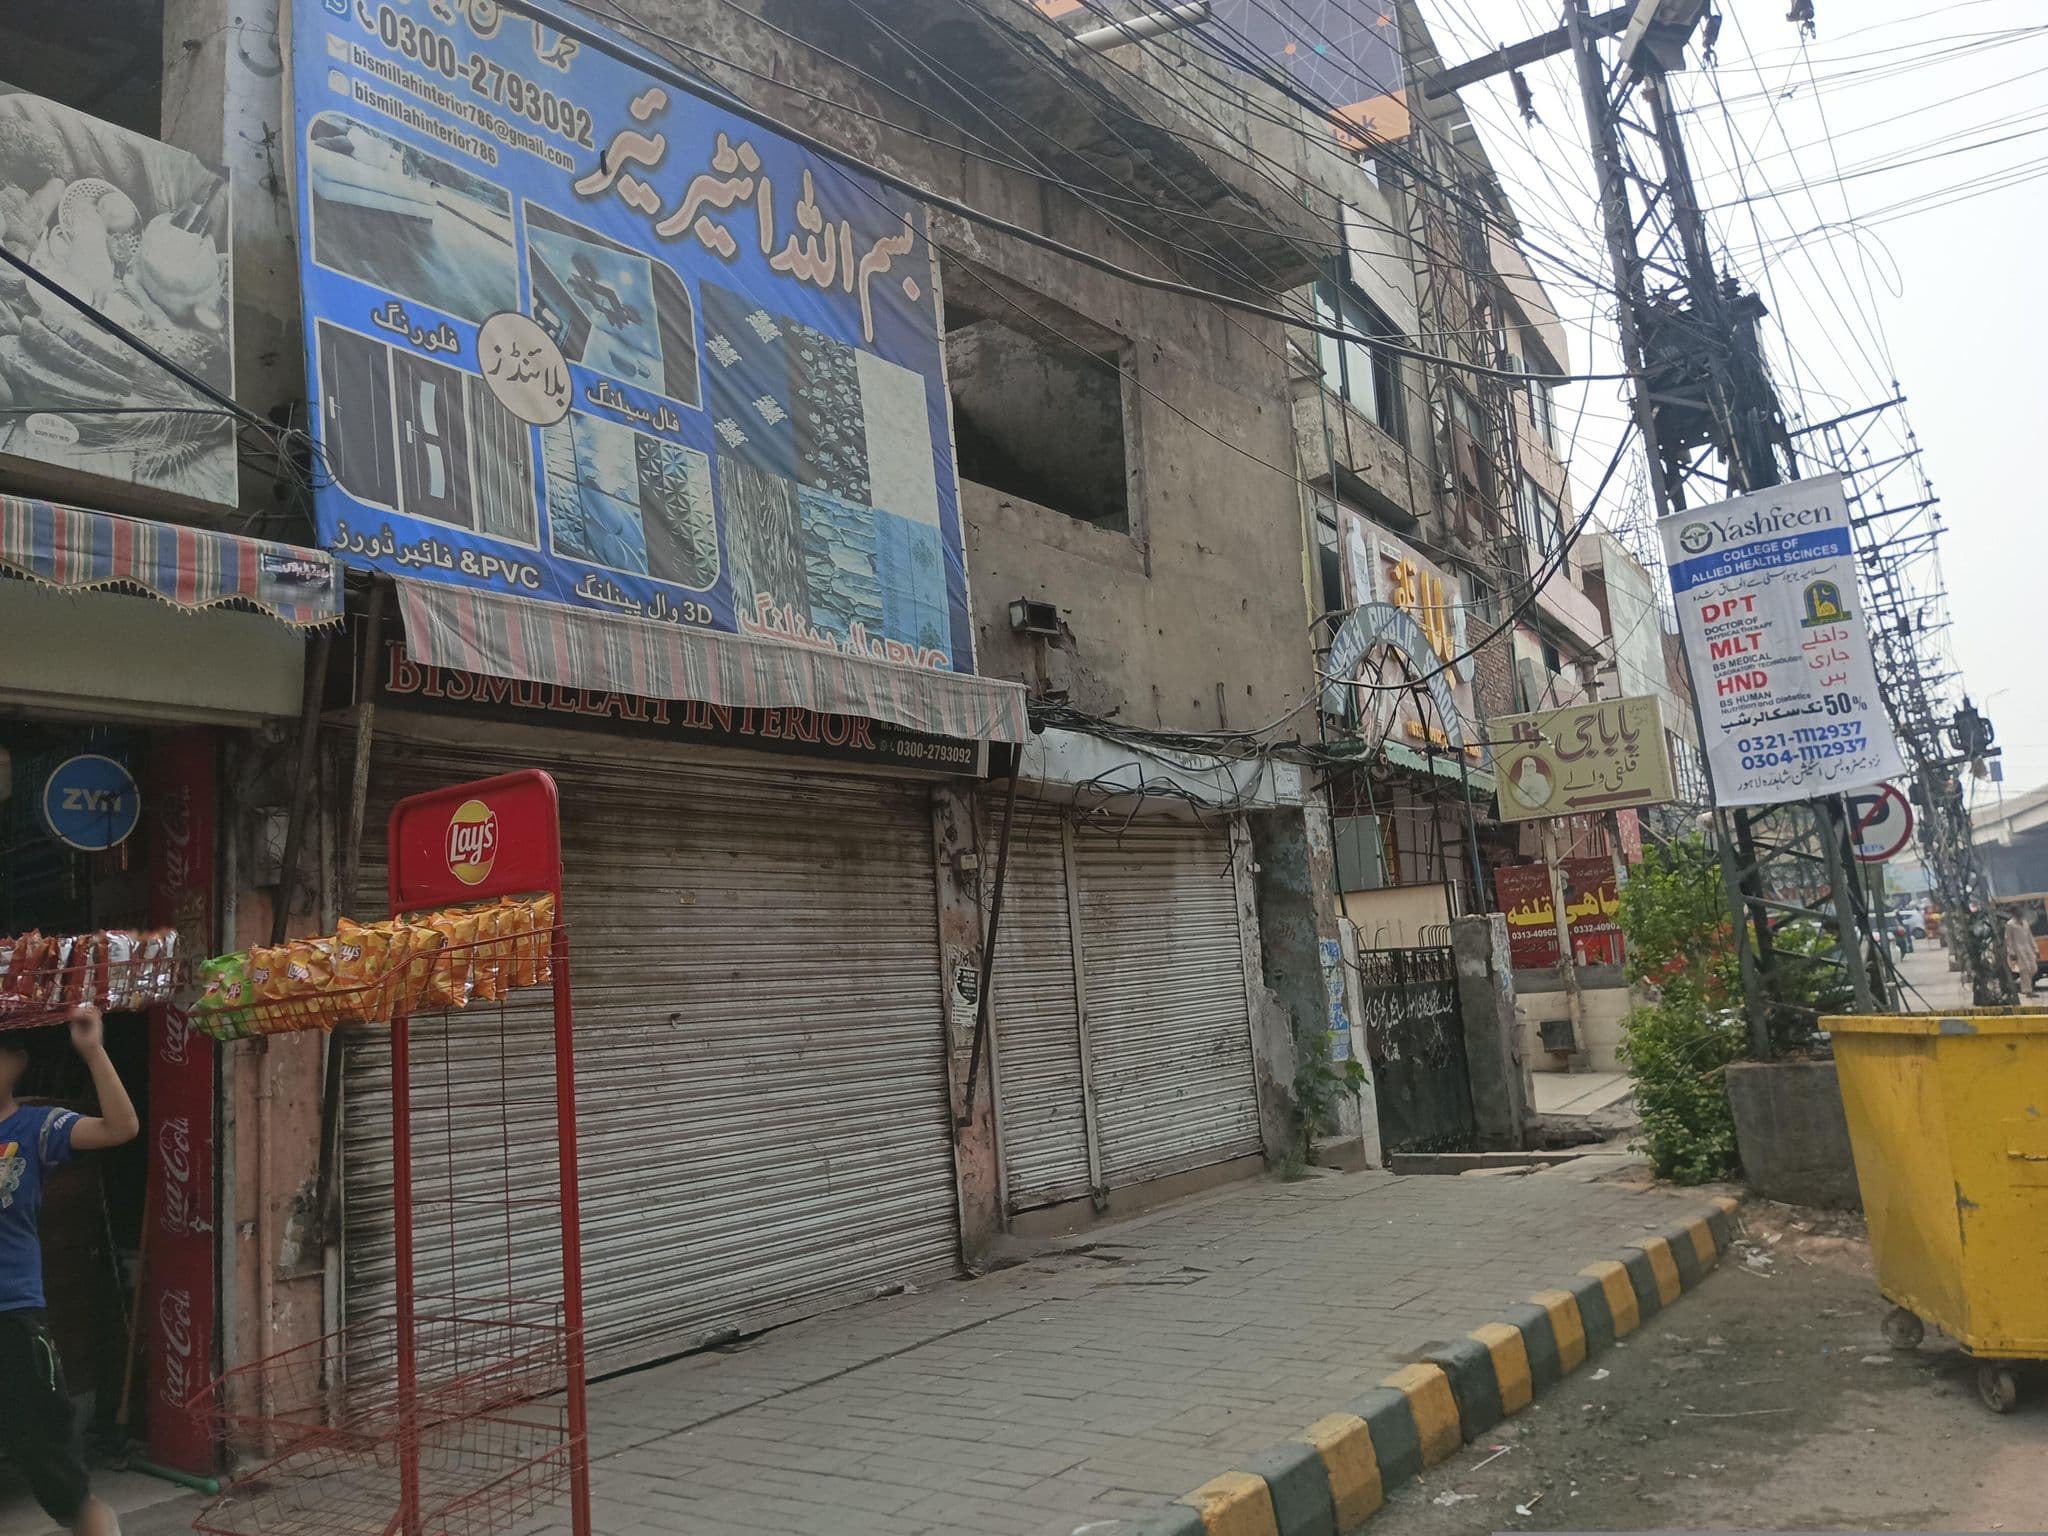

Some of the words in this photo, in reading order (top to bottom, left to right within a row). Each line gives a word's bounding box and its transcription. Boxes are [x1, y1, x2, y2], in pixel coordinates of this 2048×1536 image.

[380, 6, 595, 149] 0300-2793092
[353, 45, 574, 172] bismillahinterior786@gmail.com
[354, 82, 497, 165] bismillahinterior786
[859, 212, 920, 342] بسم
[373, 305, 459, 353] فلورنگ
[586, 383, 649, 424] سیلنگ
[653, 406, 680, 433] فال
[1711, 506, 1831, 543] Yashfeen
[334, 522, 394, 558] ڈورز
[397, 541, 453, 568] فائبر
[1723, 543, 1778, 562] COLLEGE
[1782, 539, 1799, 549] OF
[1692, 566, 1732, 584] ALLIED
[1735, 555, 1781, 573] HEALTH
[1784, 544, 1838, 561] SCINCES
[684, 601, 713, 624] 3D
[1701, 594, 1756, 623] DPT
[1704, 620, 1743, 635] DOCTOR
[1745, 617, 1758, 626] OF
[1802, 626, 1848, 650] داخلے
[1710, 632, 1762, 660] MLT
[1809, 648, 1850, 669] جاری
[1368, 606, 1417, 656] PUBLIC
[1424, 649, 1461, 744] SCHOOL
[1713, 662, 1726, 672] BS
[1728, 653, 1772, 669] MEDICAL
[1717, 671, 1768, 696] HND
[1720, 698, 1733, 709] BS
[1736, 691, 1771, 705] HUMAN
[1721, 702, 1756, 715] Nutrition
[1758, 697, 1774, 708] and
[1738, 721, 1861, 753] 0321-1112937
[896, 740, 971, 764] 0300-2793092
[1742, 738, 1867, 770] 0304-1112937
[1605, 754, 1639, 791] قلفی
[62, 787, 121, 813] ZYN
[451, 819, 494, 865] Lay's
